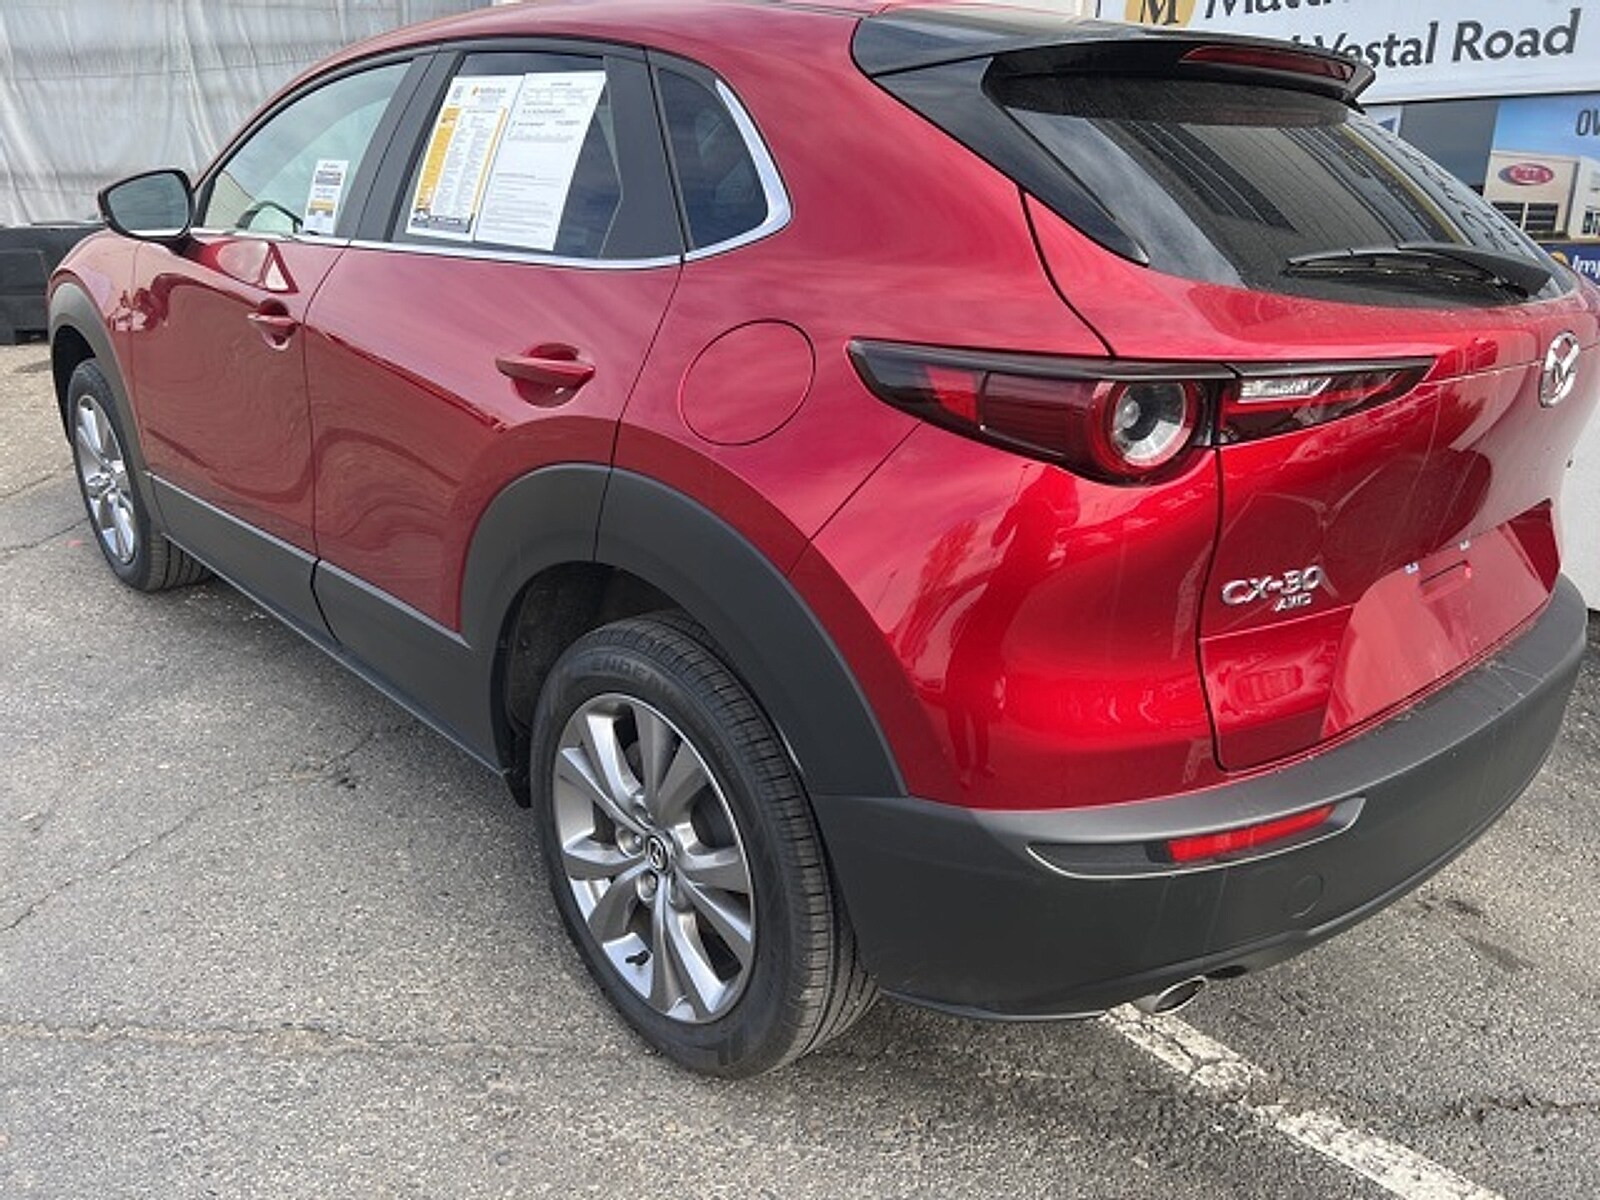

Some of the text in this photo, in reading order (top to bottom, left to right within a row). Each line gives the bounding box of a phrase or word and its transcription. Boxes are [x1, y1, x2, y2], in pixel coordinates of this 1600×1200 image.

[1314, 8, 1581, 69] Vestal Road
[1222, 565, 1321, 605] CX-30
